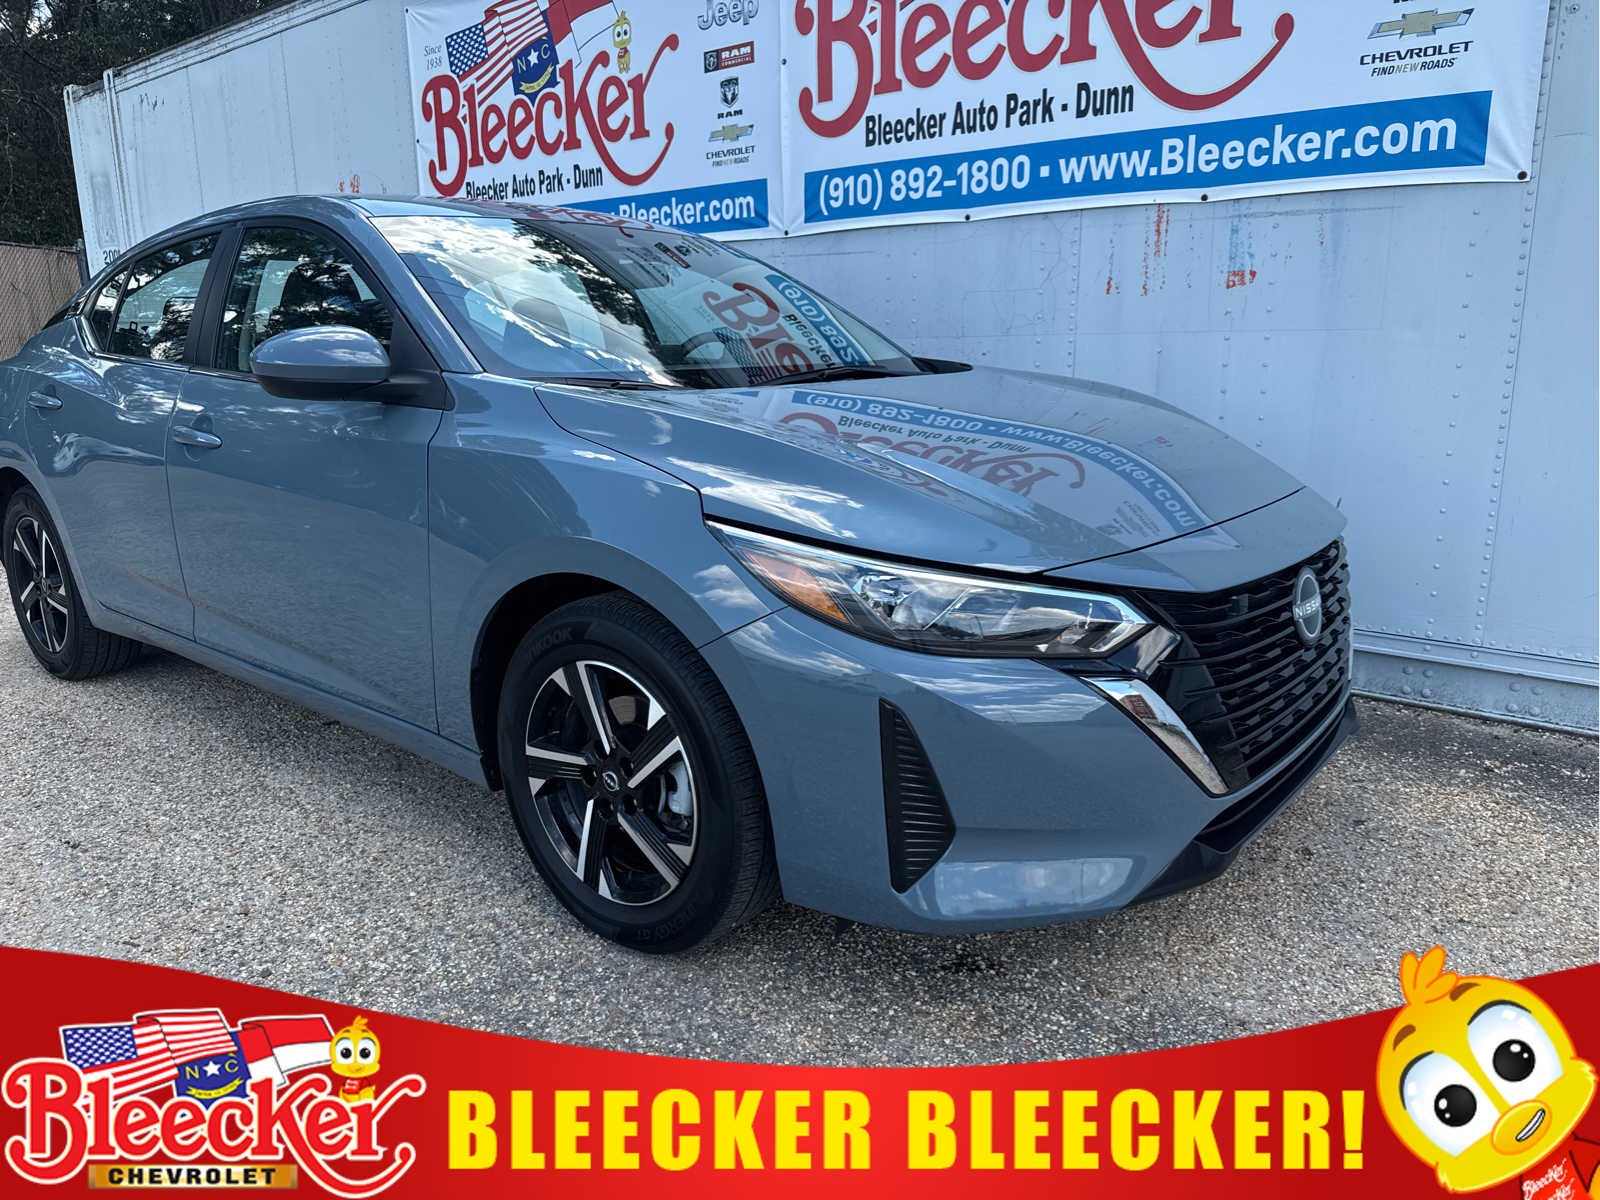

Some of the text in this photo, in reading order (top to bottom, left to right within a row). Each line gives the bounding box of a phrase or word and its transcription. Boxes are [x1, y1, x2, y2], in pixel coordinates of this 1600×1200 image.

[697, 0, 759, 31] Jeep
[721, 45, 751, 60] RAM
[1360, 40, 1474, 65] CHEVROLET
[421, 33, 680, 197] Bleecker
[717, 109, 743, 119] RAM
[865, 106, 946, 148] Bleecker
[951, 100, 999, 137] Auto
[1006, 90, 1054, 129] Park
[1075, 82, 1134, 119] Dunn
[706, 145, 755, 160] CHEVROLET
[818, 117, 1457, 215] (910) 892-1800 www.Bleecker.com
[466, 178, 509, 200] Bleecker
[512, 173, 536, 199] Auto
[538, 167, 564, 195] Park
[573, 164, 603, 190] Dunn
